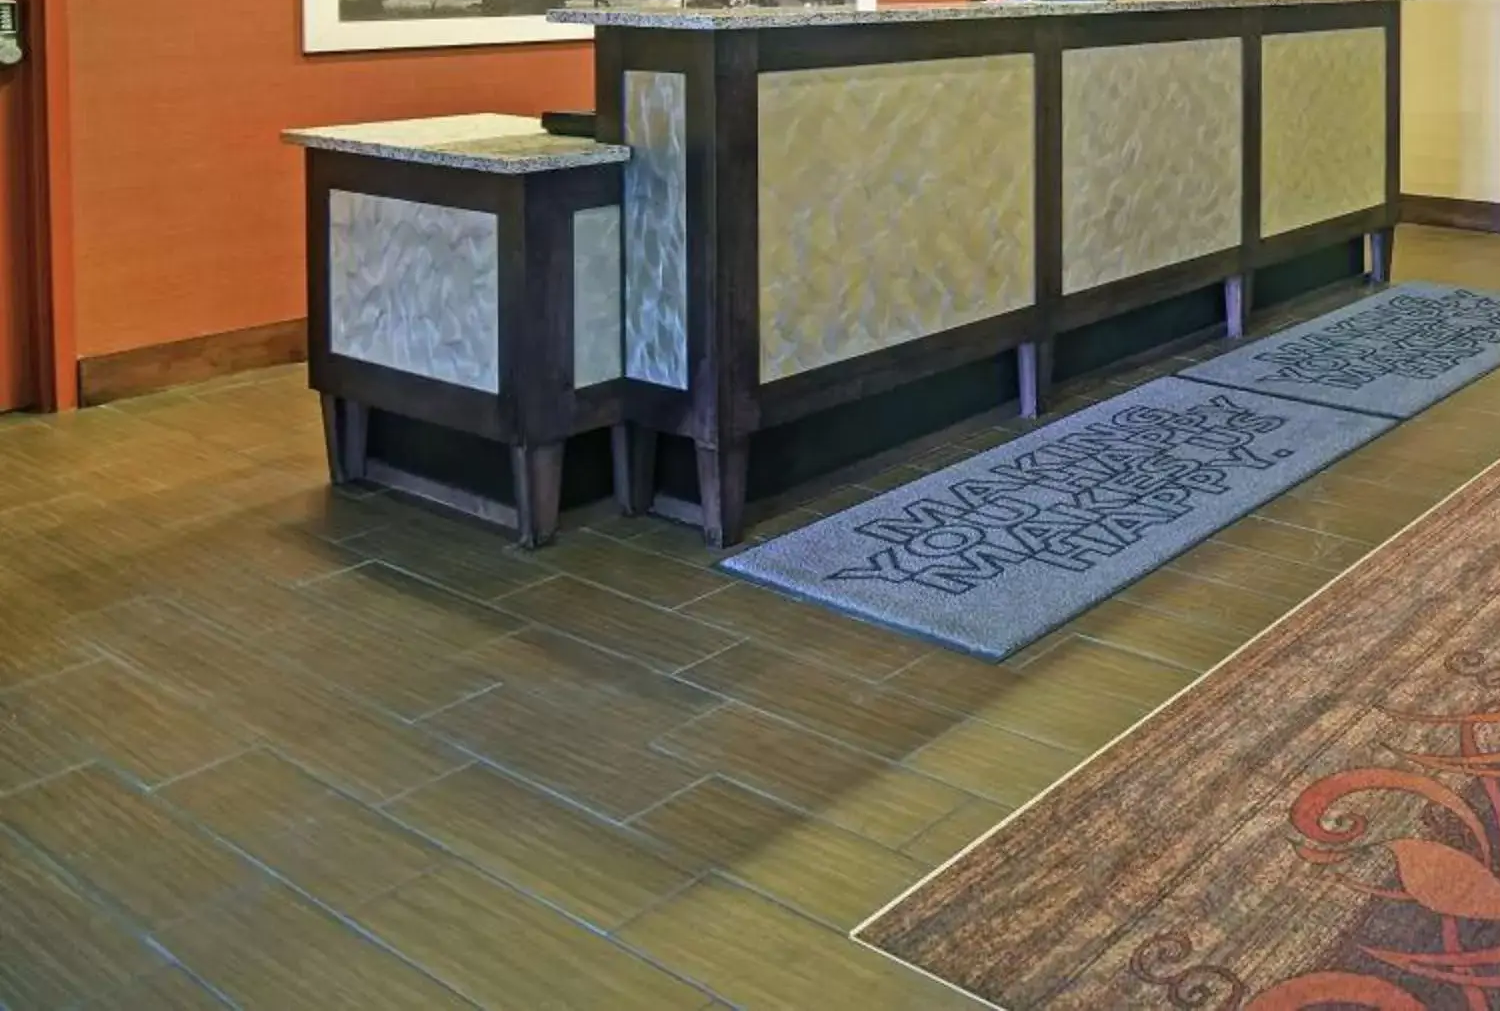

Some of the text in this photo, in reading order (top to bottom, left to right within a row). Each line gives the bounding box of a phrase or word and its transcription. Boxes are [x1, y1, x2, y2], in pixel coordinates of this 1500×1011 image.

[825, 395, 1249, 583] YOU HAPPY
[853, 404, 1181, 544] MAKING
[909, 414, 1286, 594] MAKES US
[1039, 446, 1296, 573] HAPPY.
